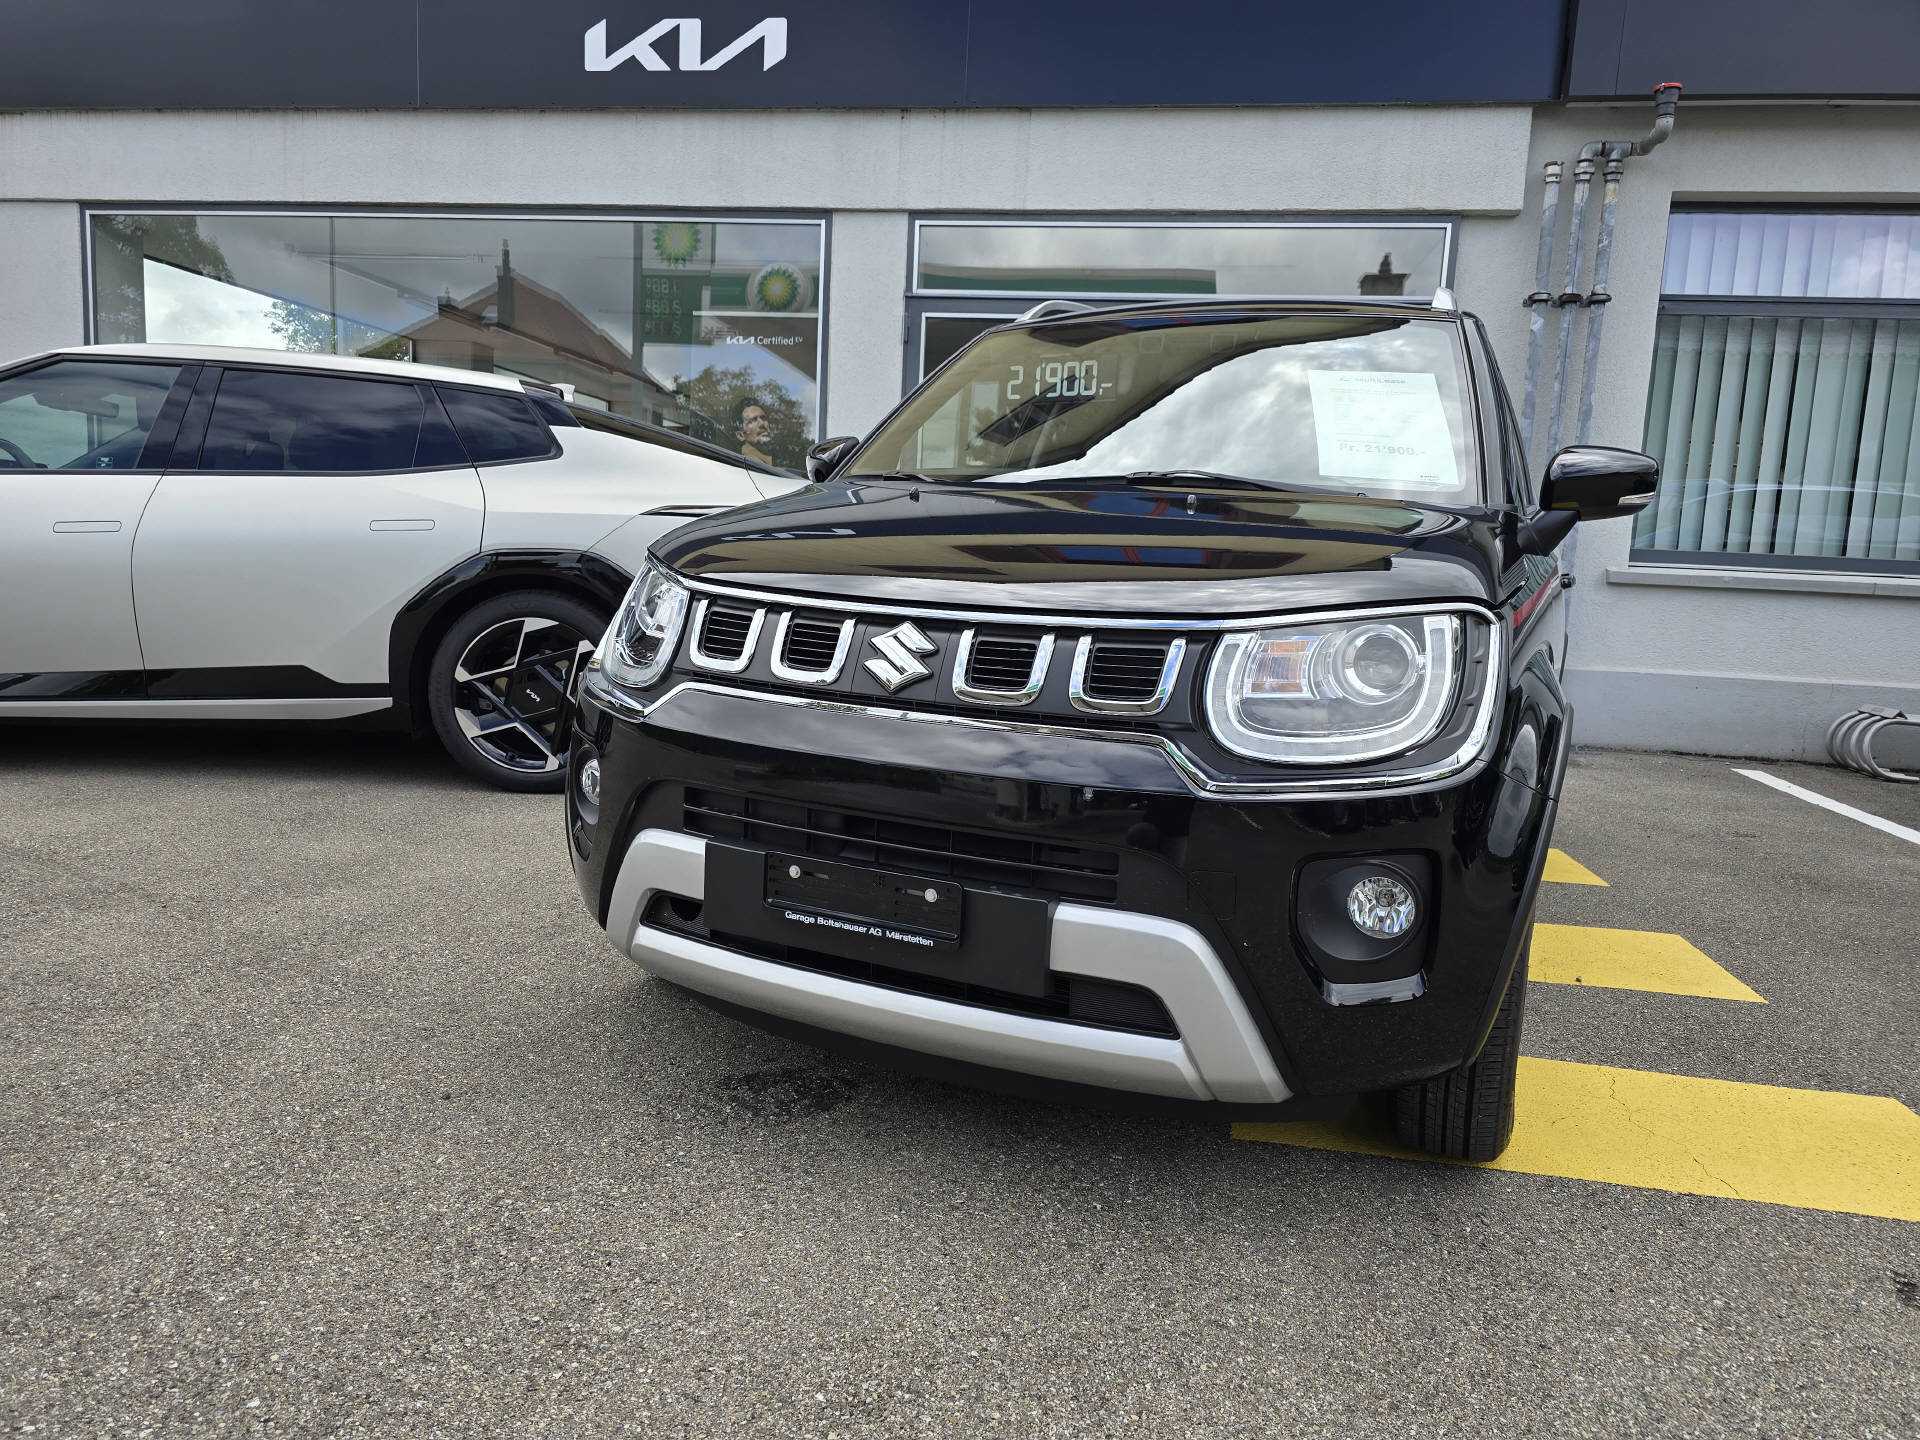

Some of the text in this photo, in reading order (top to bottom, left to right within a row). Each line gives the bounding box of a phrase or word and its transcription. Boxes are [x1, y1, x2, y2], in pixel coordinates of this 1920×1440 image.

[757, 335, 794, 345] Certified
[785, 911, 934, 947] Garage Boltshauser AG Märstetten
